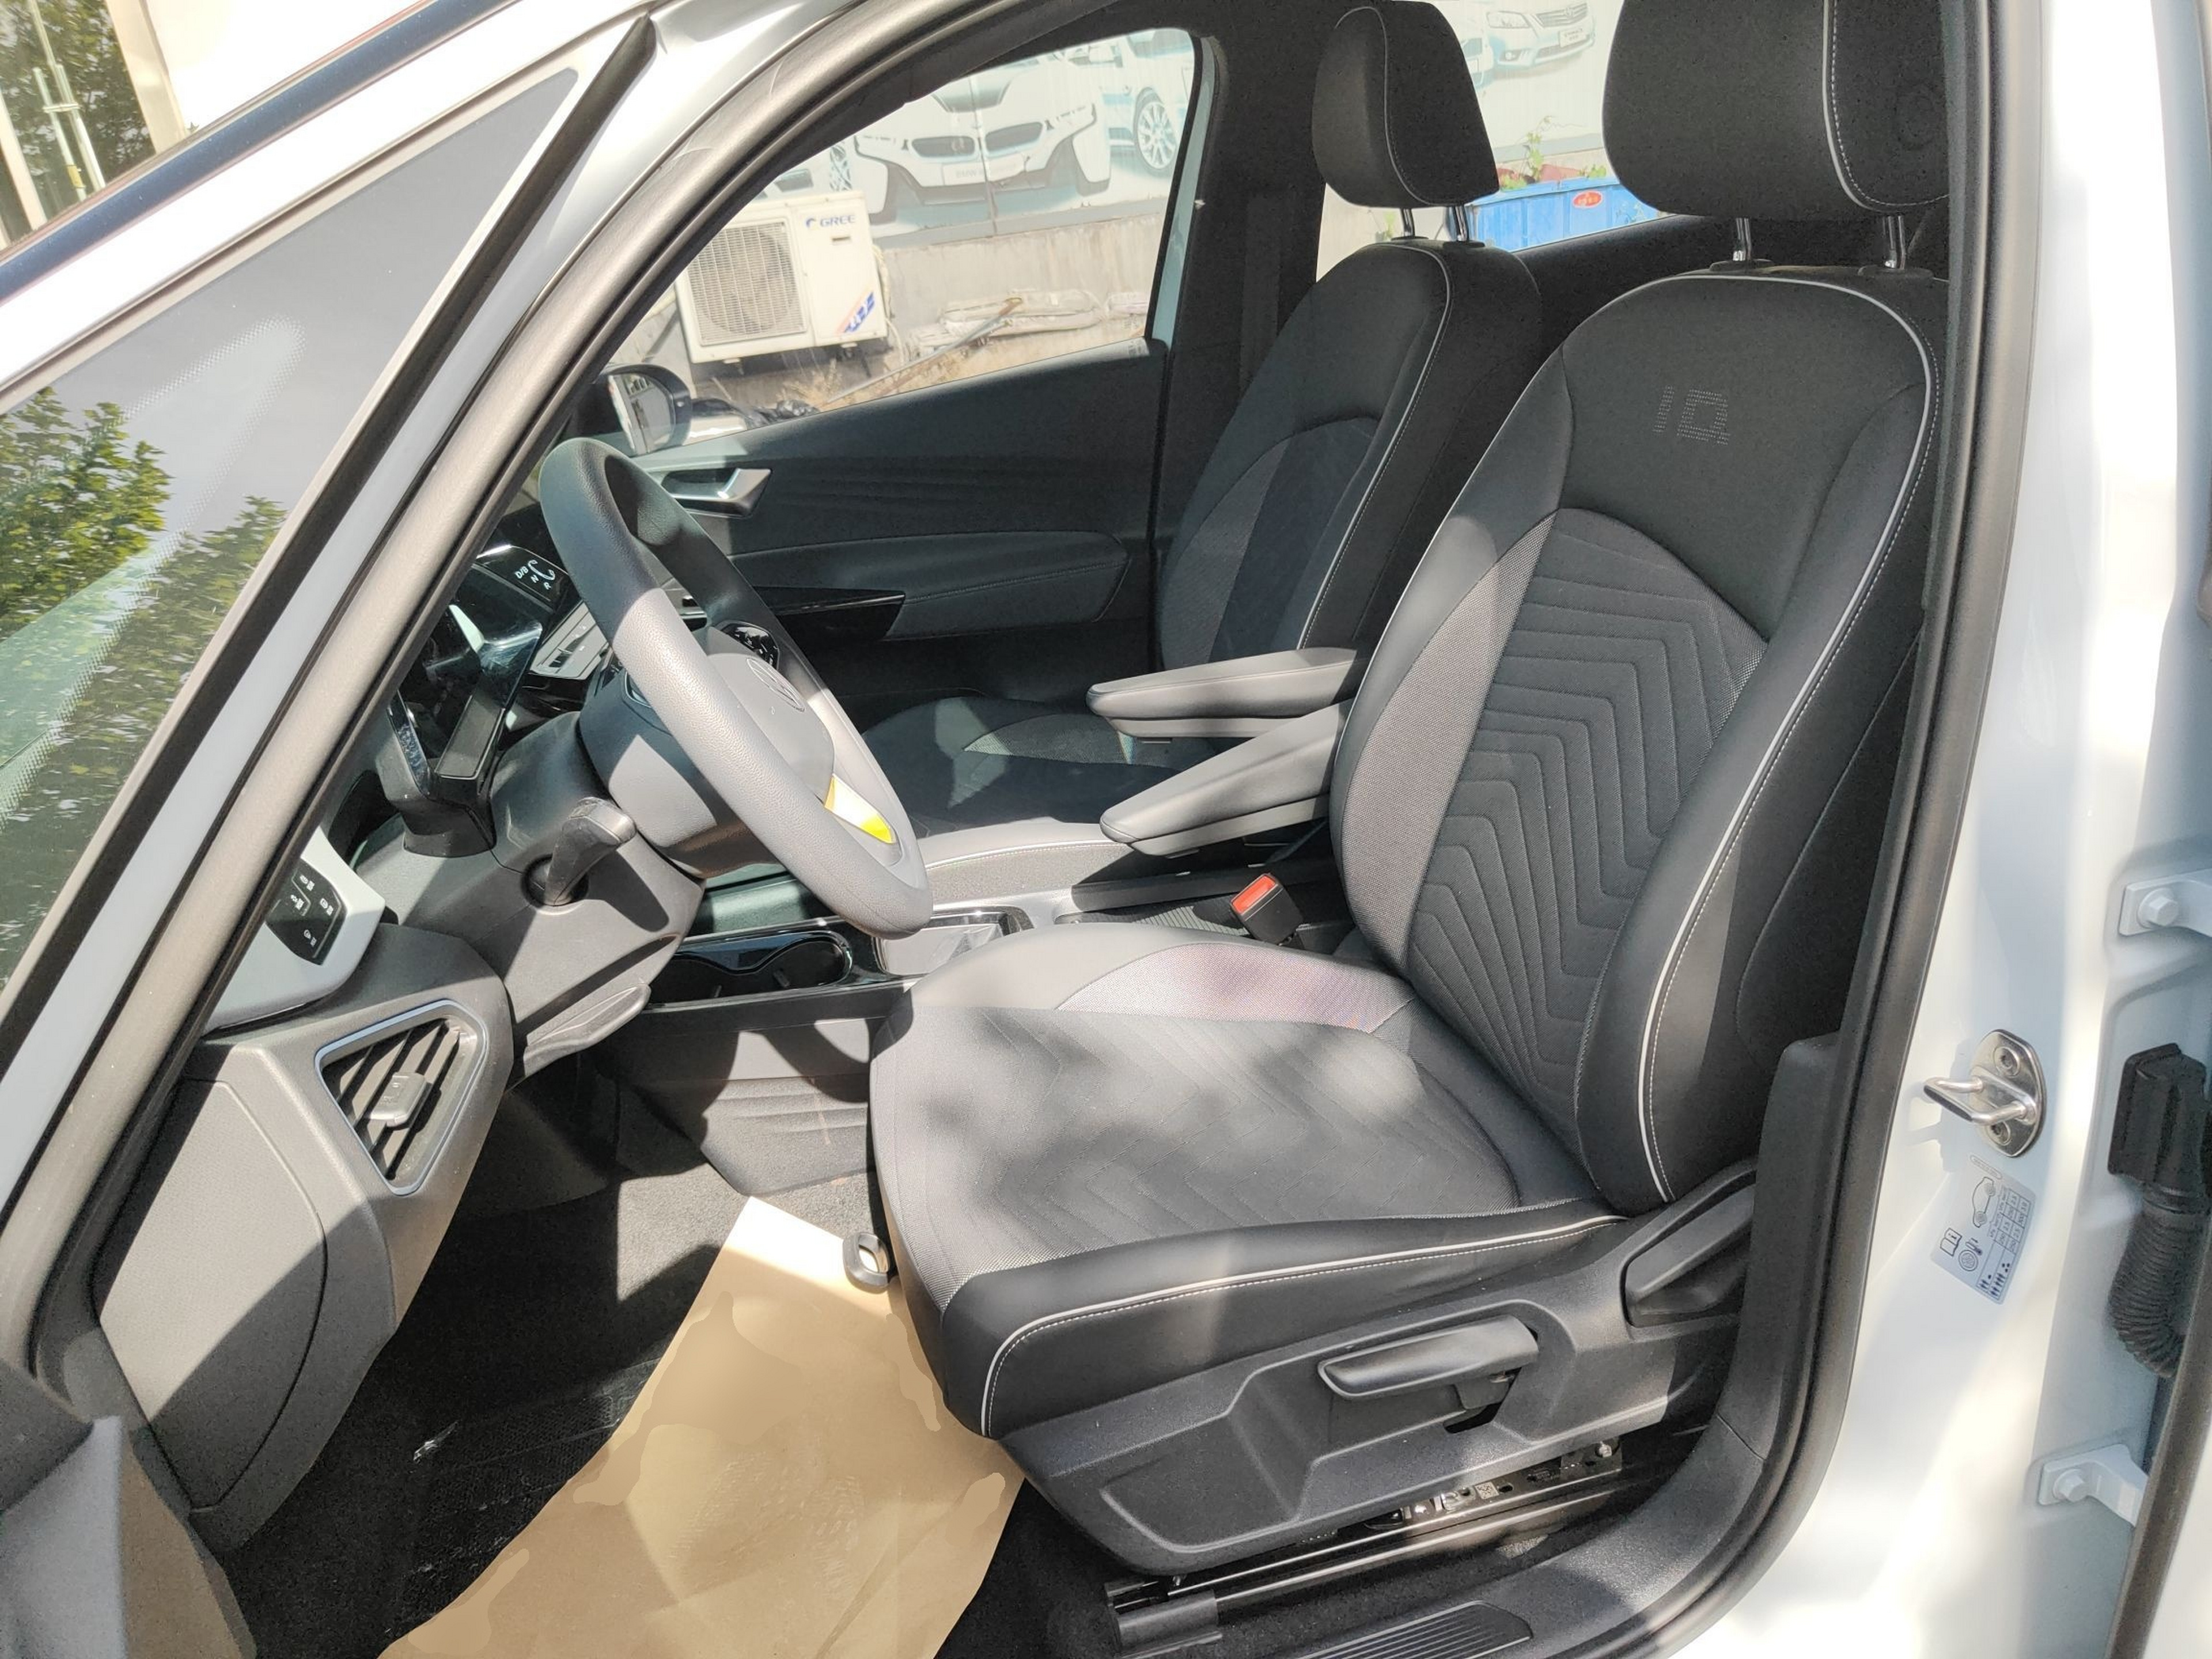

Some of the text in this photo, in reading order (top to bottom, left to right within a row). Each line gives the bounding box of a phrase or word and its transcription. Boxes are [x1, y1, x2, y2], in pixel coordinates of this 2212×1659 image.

[820, 214, 856, 228] GREE
[514, 566, 529, 579] D/B
[531, 574, 539, 584] N
[543, 582, 552, 590] R
